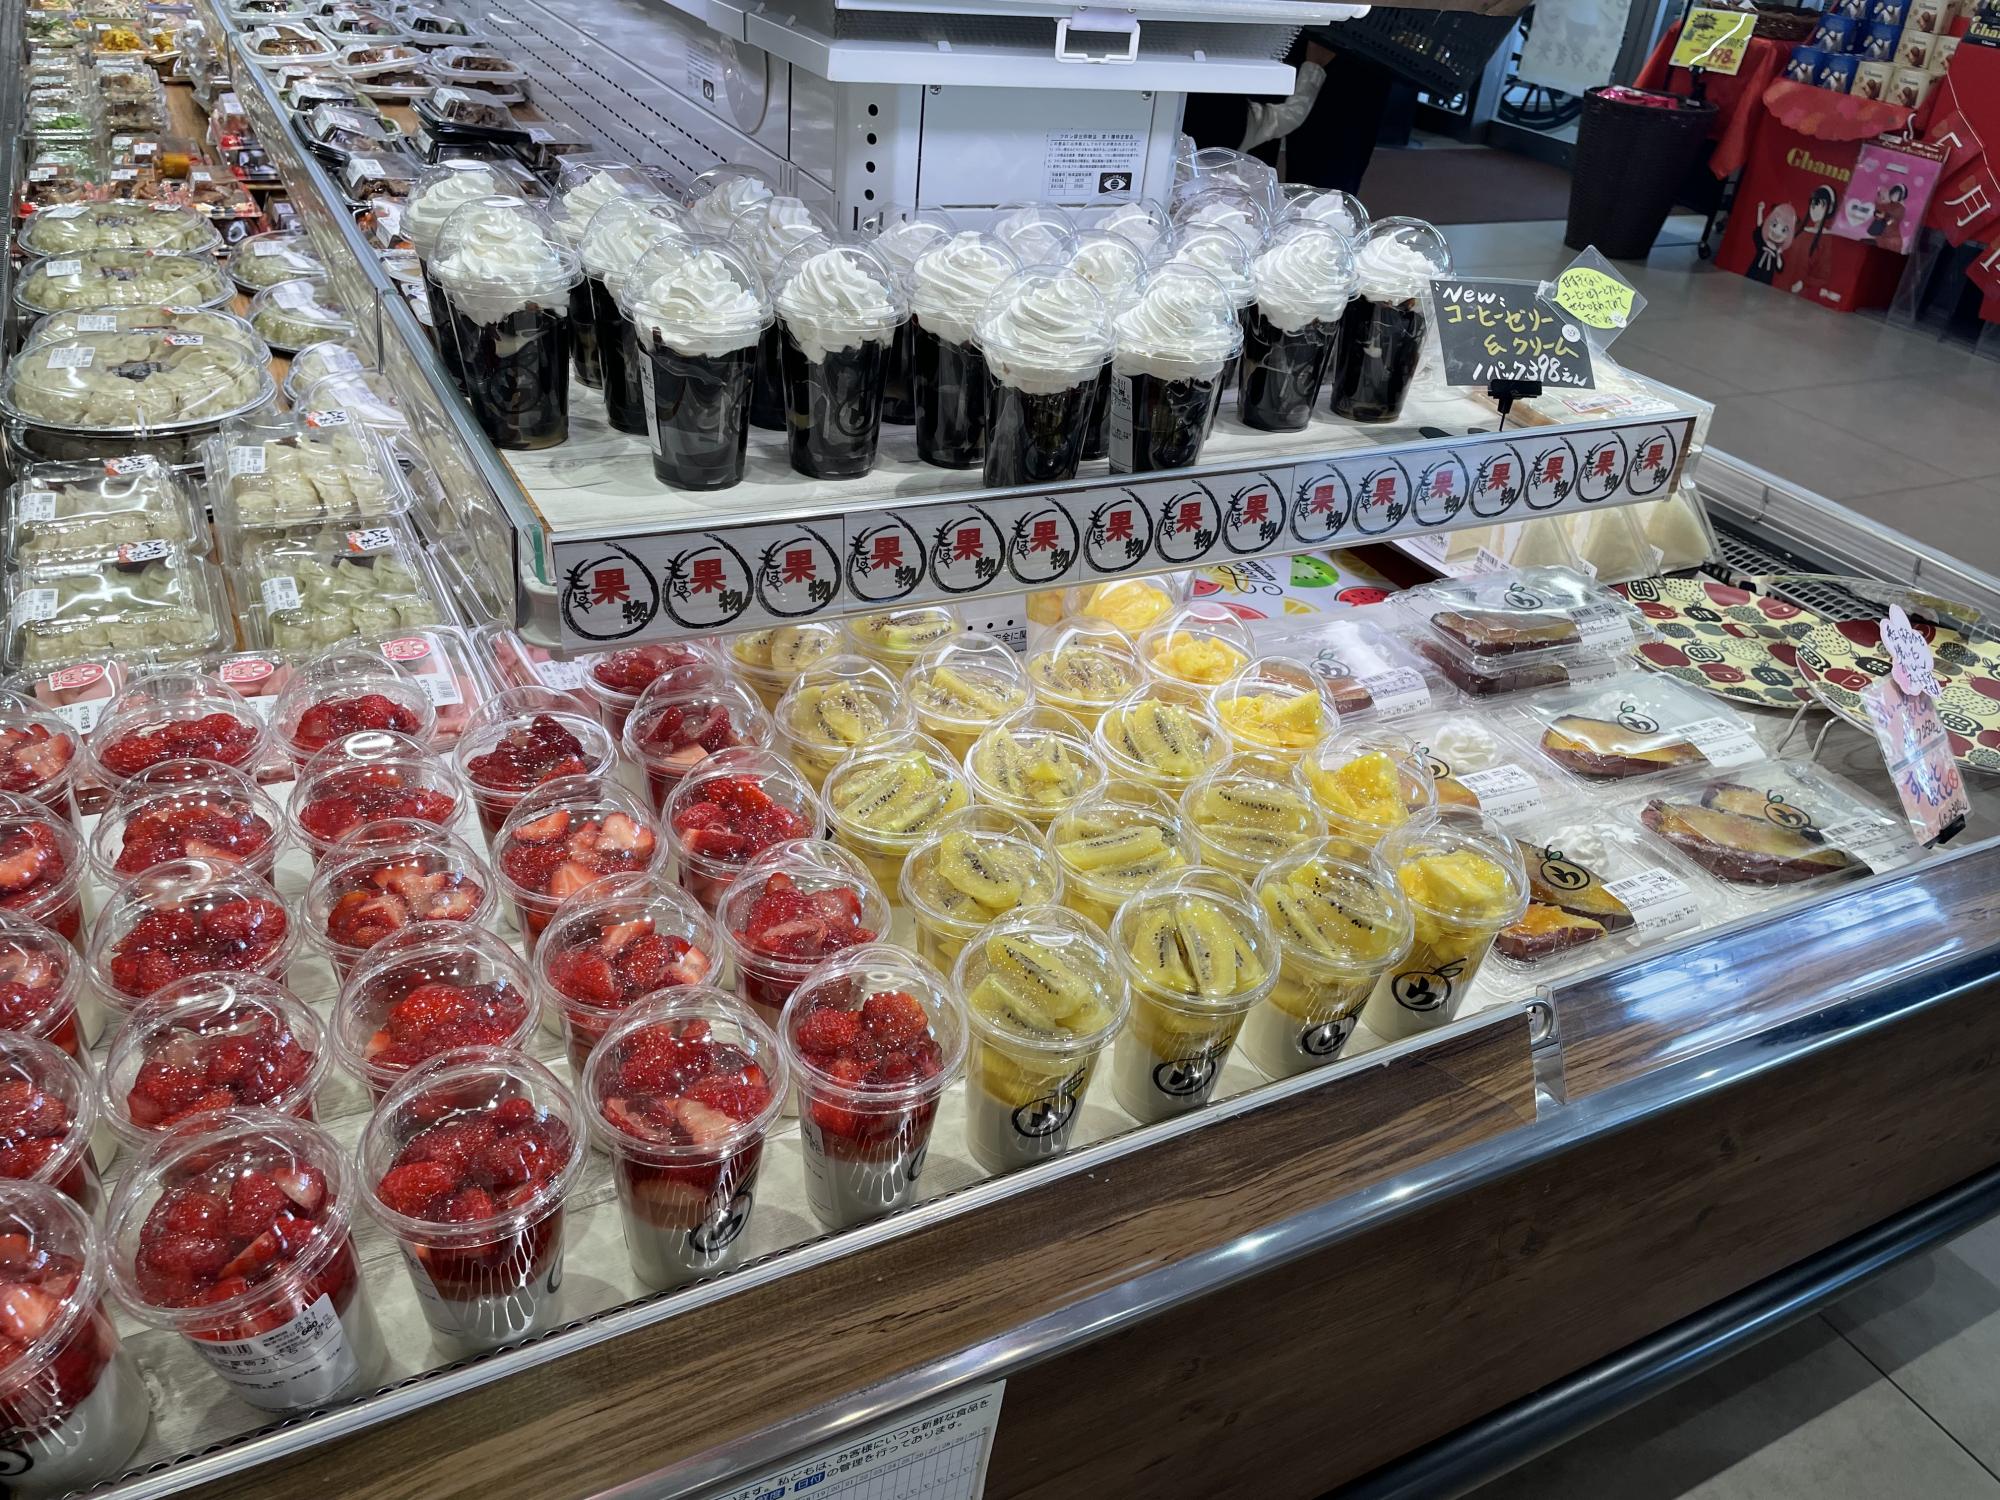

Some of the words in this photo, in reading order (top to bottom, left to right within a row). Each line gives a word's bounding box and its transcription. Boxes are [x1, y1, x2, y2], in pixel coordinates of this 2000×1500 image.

[1786, 146, 1851, 183] Ghana
[1443, 305, 1554, 333] コーヒーゼリー
